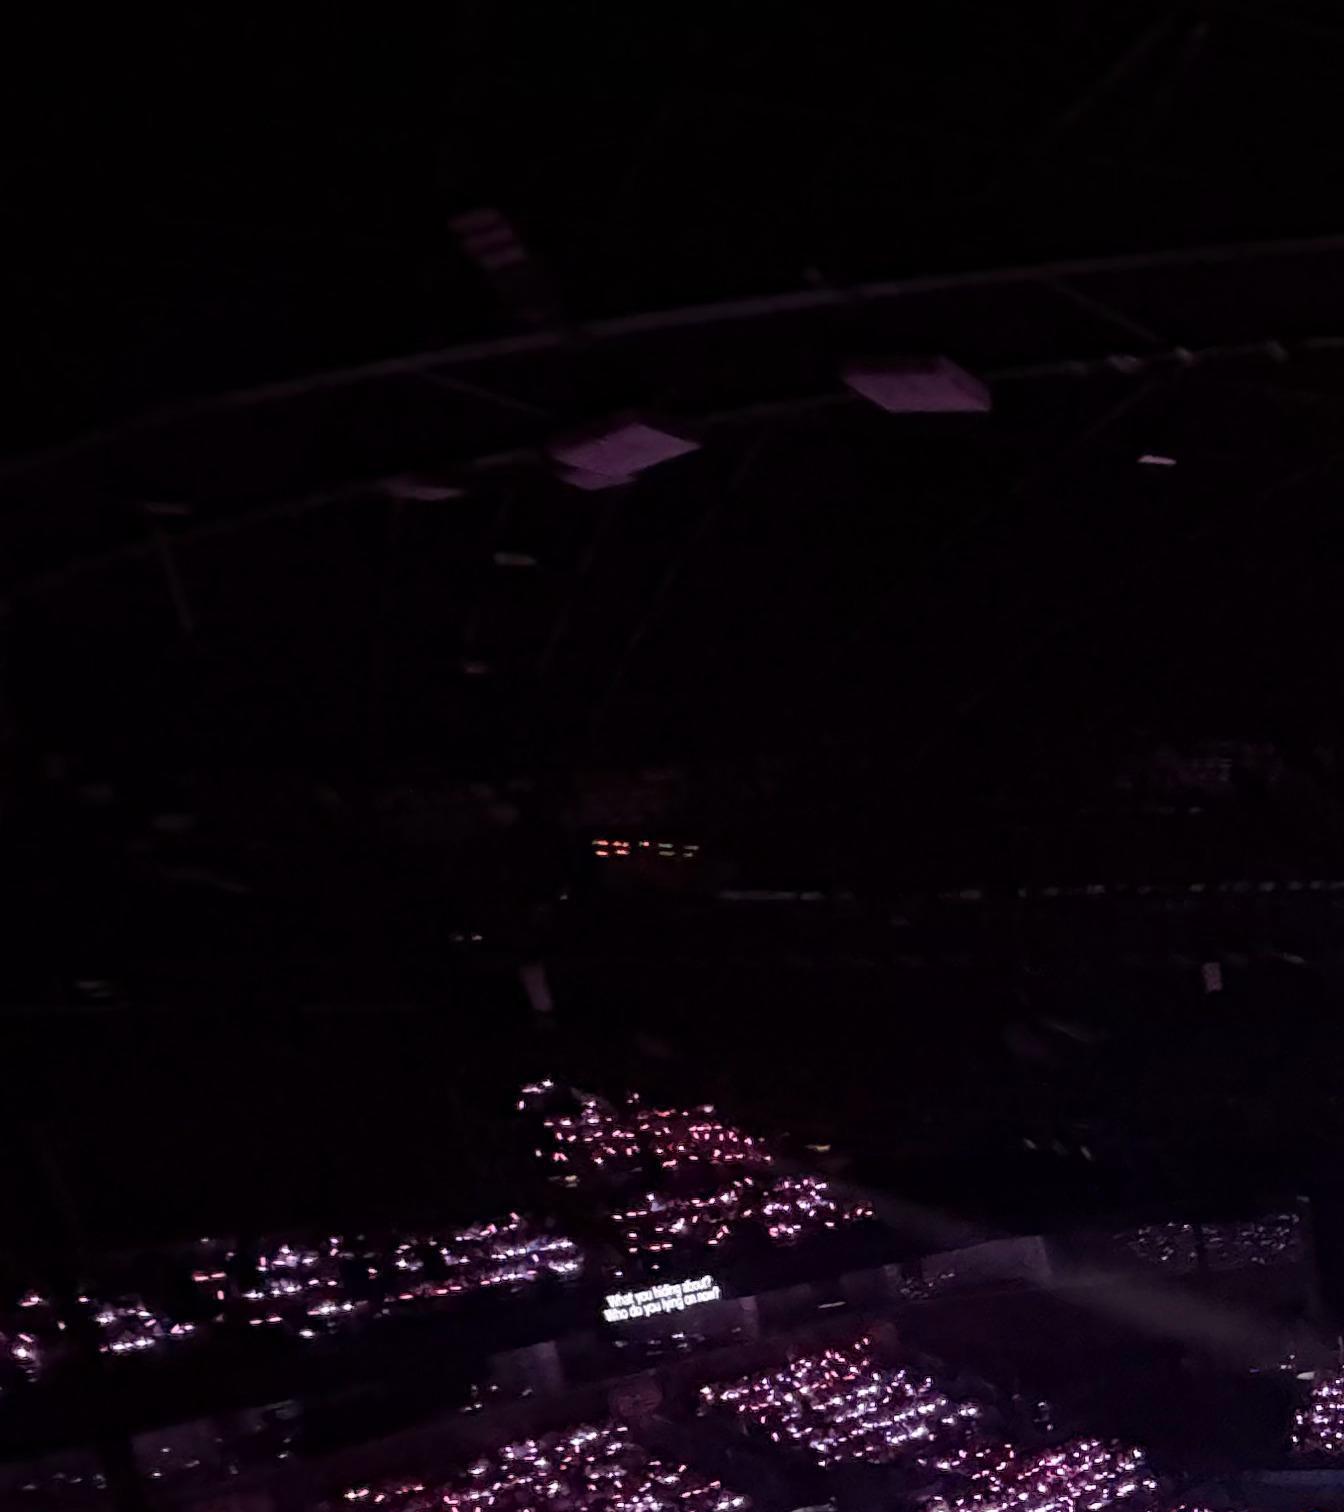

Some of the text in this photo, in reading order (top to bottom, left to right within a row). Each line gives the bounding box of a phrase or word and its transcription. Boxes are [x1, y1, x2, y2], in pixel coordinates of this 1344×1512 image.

[603, 1285, 721, 1322] Who do you lying on now?
[605, 1292, 634, 1308] What
[634, 1290, 653, 1305] you
[682, 1275, 712, 1294] about?
